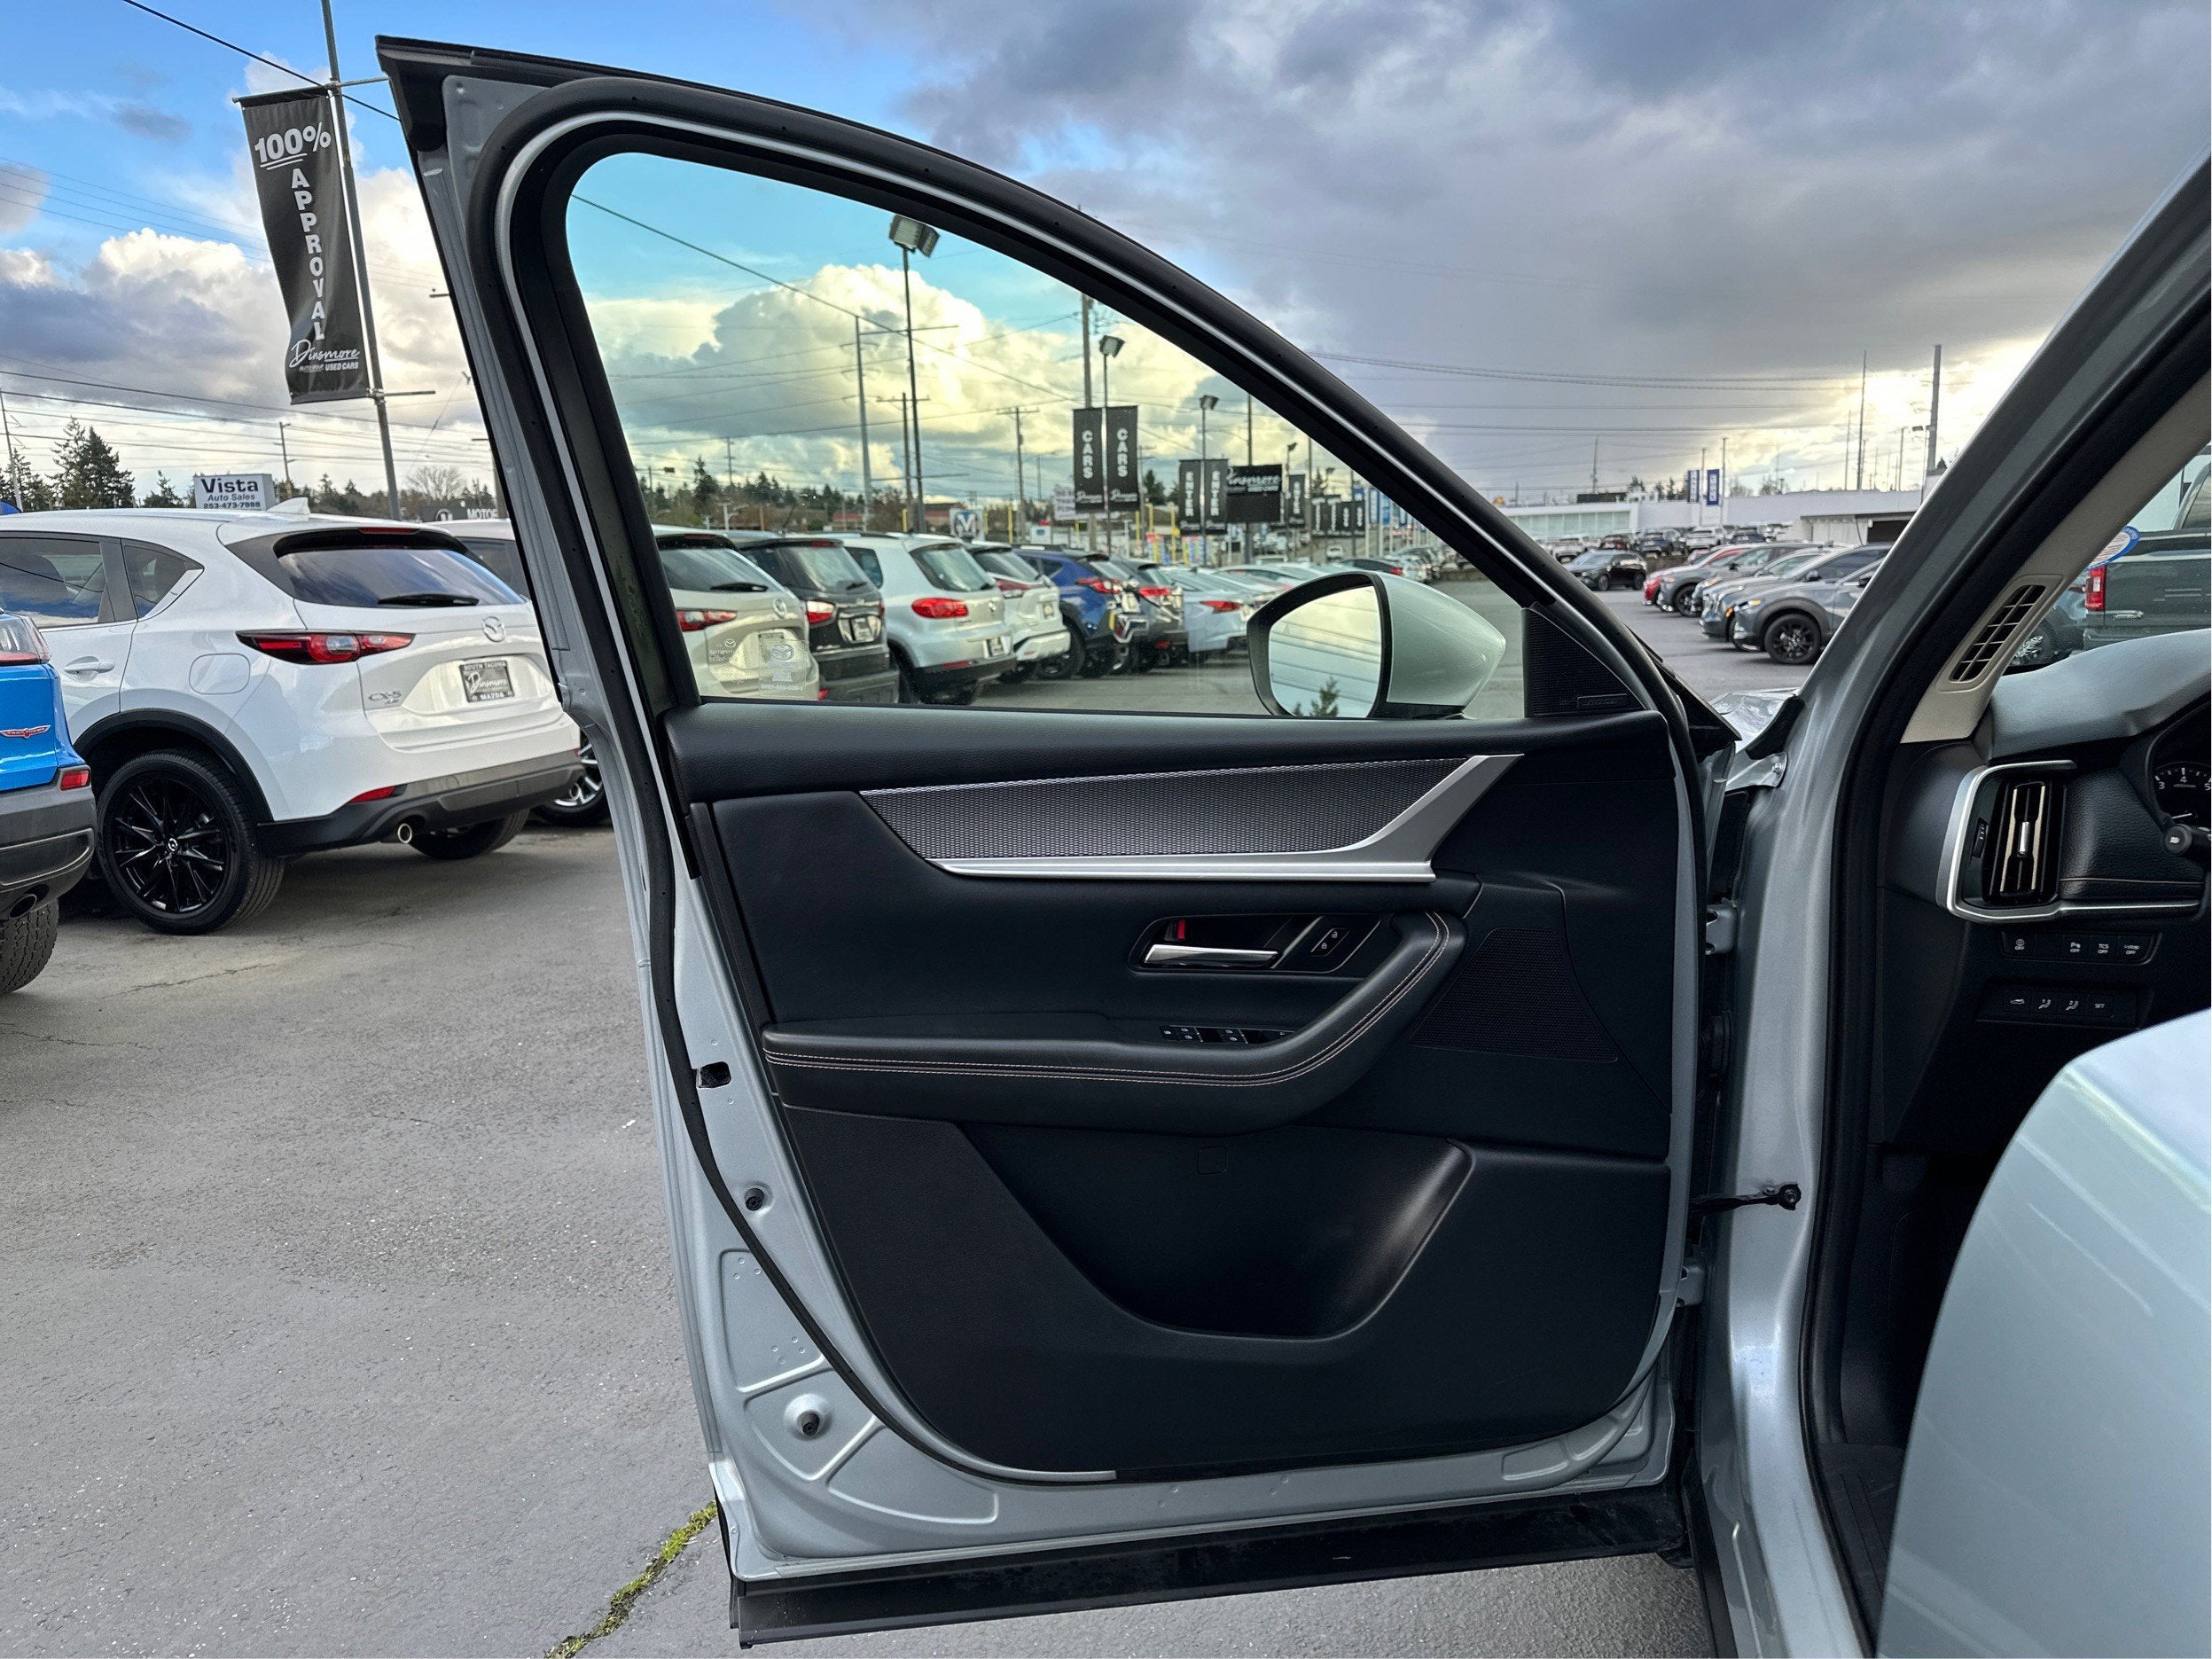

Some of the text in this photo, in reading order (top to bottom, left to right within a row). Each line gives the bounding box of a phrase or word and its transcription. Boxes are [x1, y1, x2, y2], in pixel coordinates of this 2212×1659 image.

[254, 122, 332, 163] 100%
[291, 168, 325, 340] APPROVAL
[289, 339, 360, 367] Dinsmore
[1082, 429, 1094, 479] CARS
[1117, 427, 1129, 478] CARS
[200, 477, 259, 493] Vista
[368, 692, 402, 700] CX-5
[2158, 781, 2166, 790] 3
